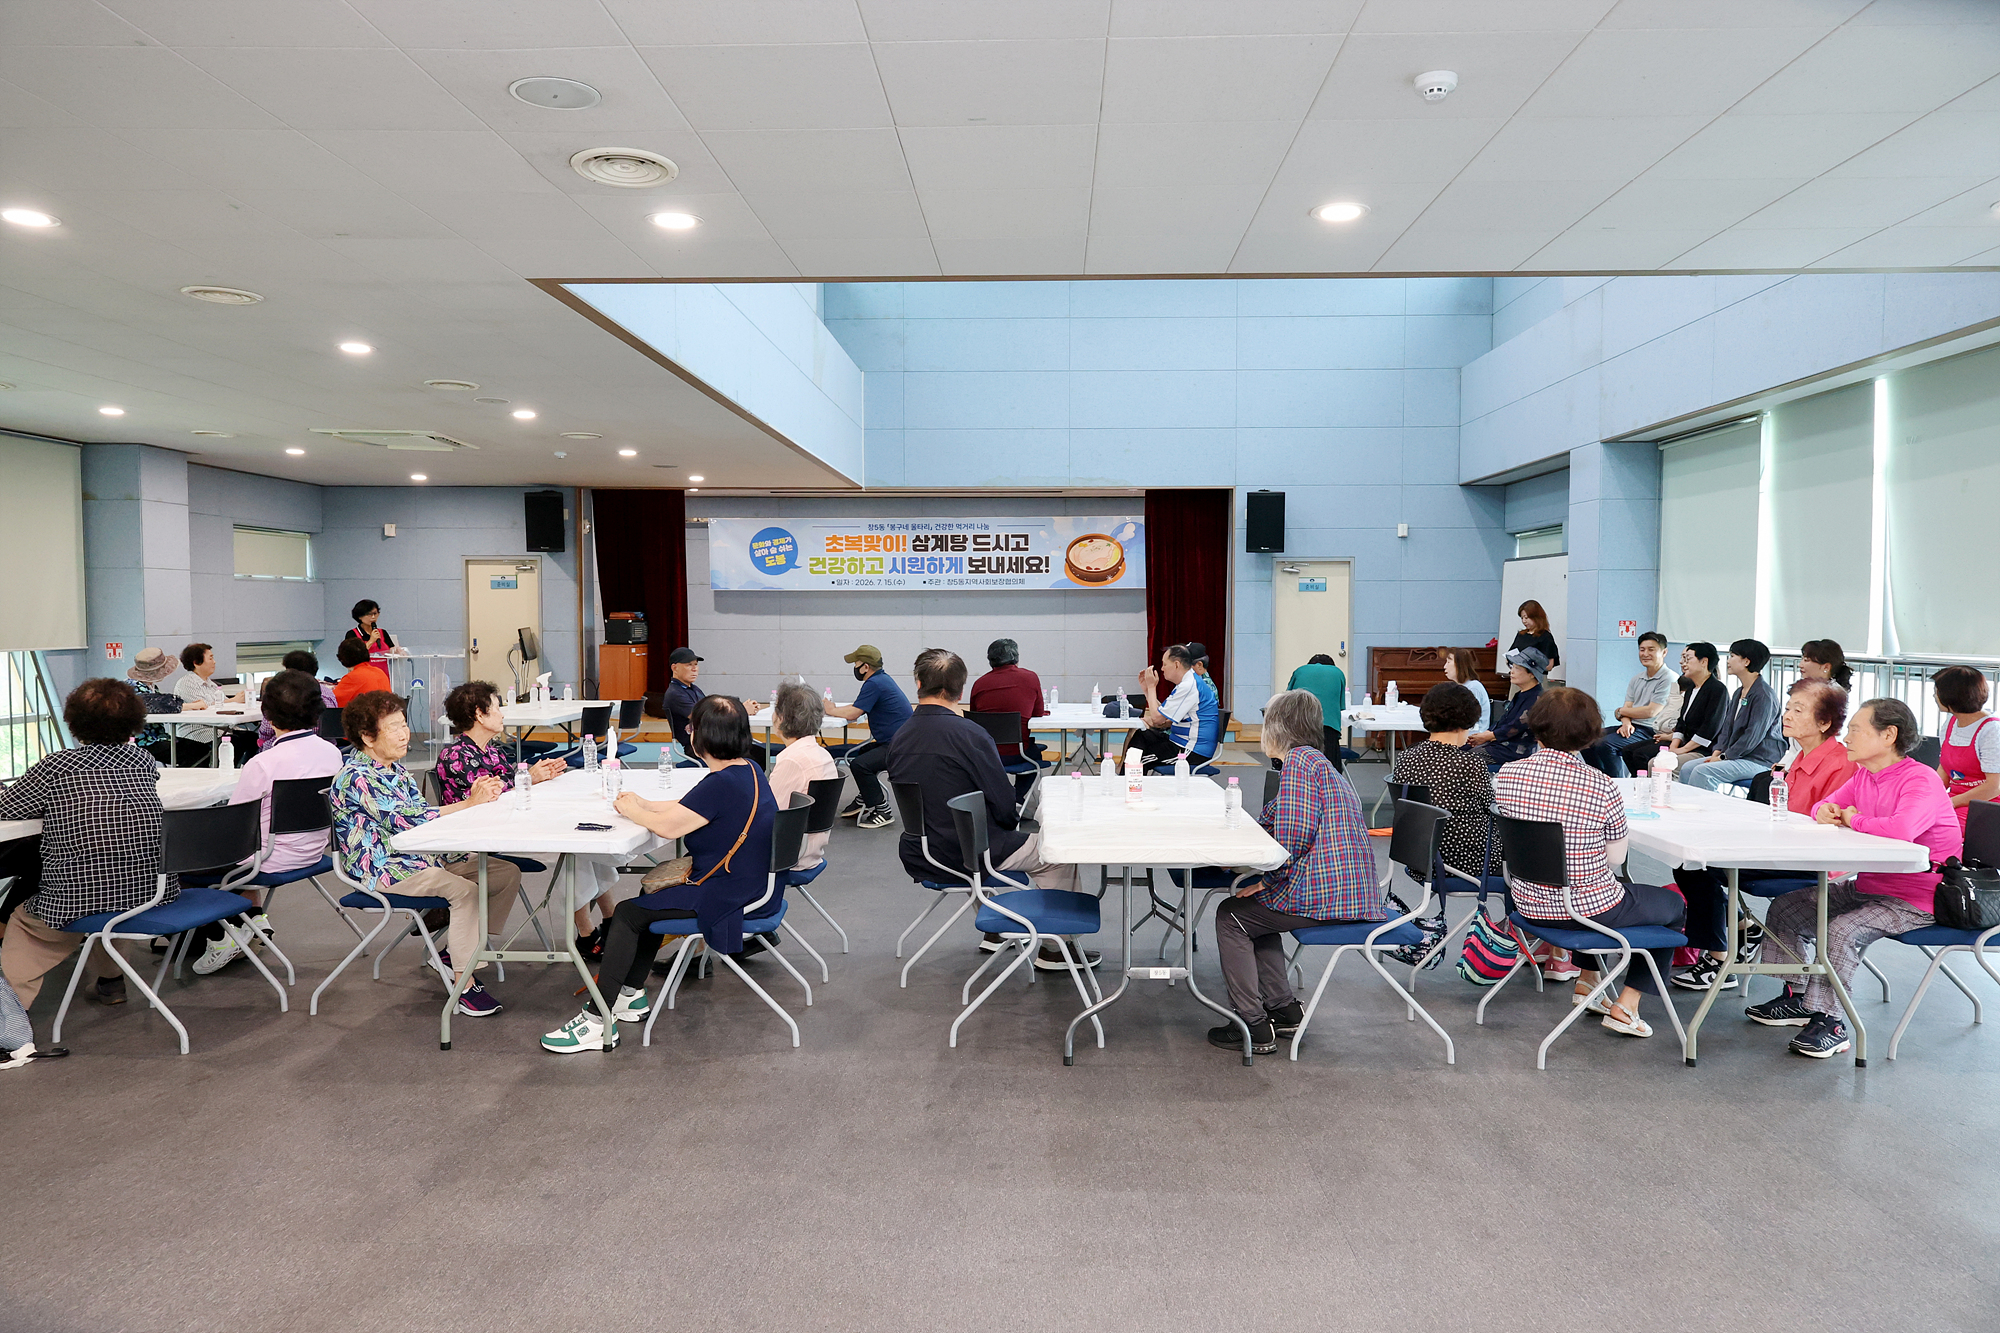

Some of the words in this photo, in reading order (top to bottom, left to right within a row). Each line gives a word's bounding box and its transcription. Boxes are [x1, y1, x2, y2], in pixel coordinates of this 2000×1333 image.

[867, 523, 886, 532] 창5동
[934, 522, 955, 531] 건강한
[955, 522, 975, 531] 먹거리
[976, 522, 990, 531] 나눔
[825, 534, 907, 553] 초복맞이!
[912, 534, 968, 552] 삼계탕
[972, 533, 1030, 552] 드시고
[765, 553, 787, 567] 도봉
[809, 556, 884, 575] 건강하고
[888, 556, 964, 575] 시원하게
[967, 555, 1050, 575] 보내세요!
[836, 578, 850, 586] 일자
[855, 578, 876, 586] 2026.
[877, 578, 883, 586] 7.
[927, 578, 942, 586] 주관
